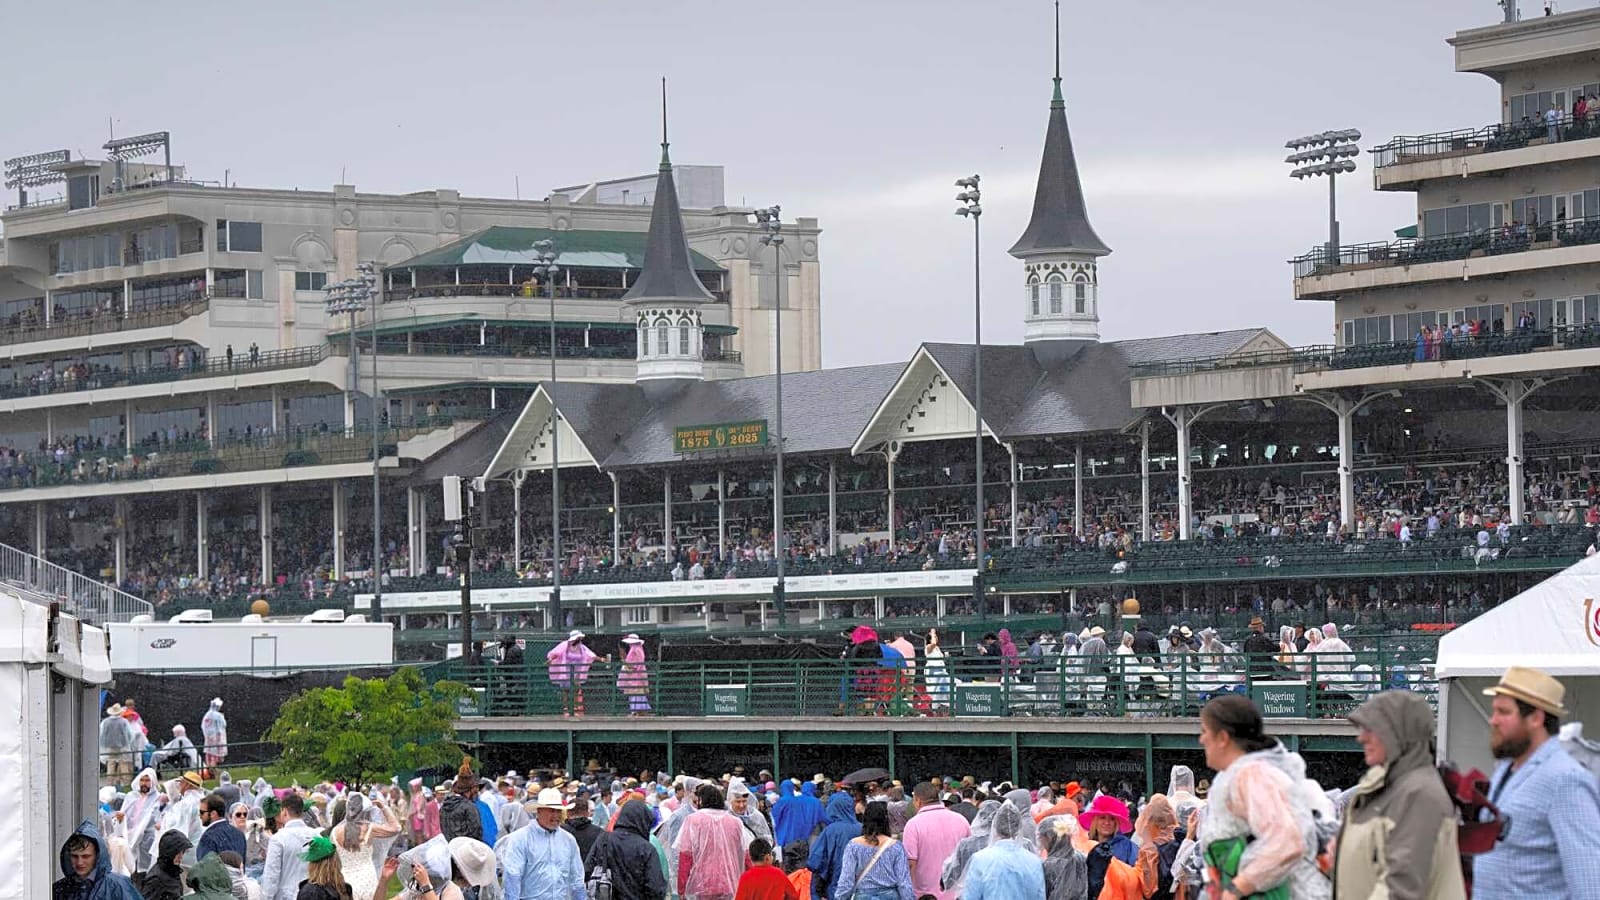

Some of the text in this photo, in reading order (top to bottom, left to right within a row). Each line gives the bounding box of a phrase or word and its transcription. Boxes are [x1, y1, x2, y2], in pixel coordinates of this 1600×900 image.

[695, 429, 713, 437] DERBY
[681, 438, 710, 448] 1875
[730, 433, 758, 445] 2025
[714, 693, 737, 704] Wagering
[965, 692, 992, 703] Wagering
[1263, 691, 1295, 704] Wagering
[714, 703, 737, 713] Windows
[965, 703, 991, 713] Windows
[1263, 704, 1295, 714] Windows
